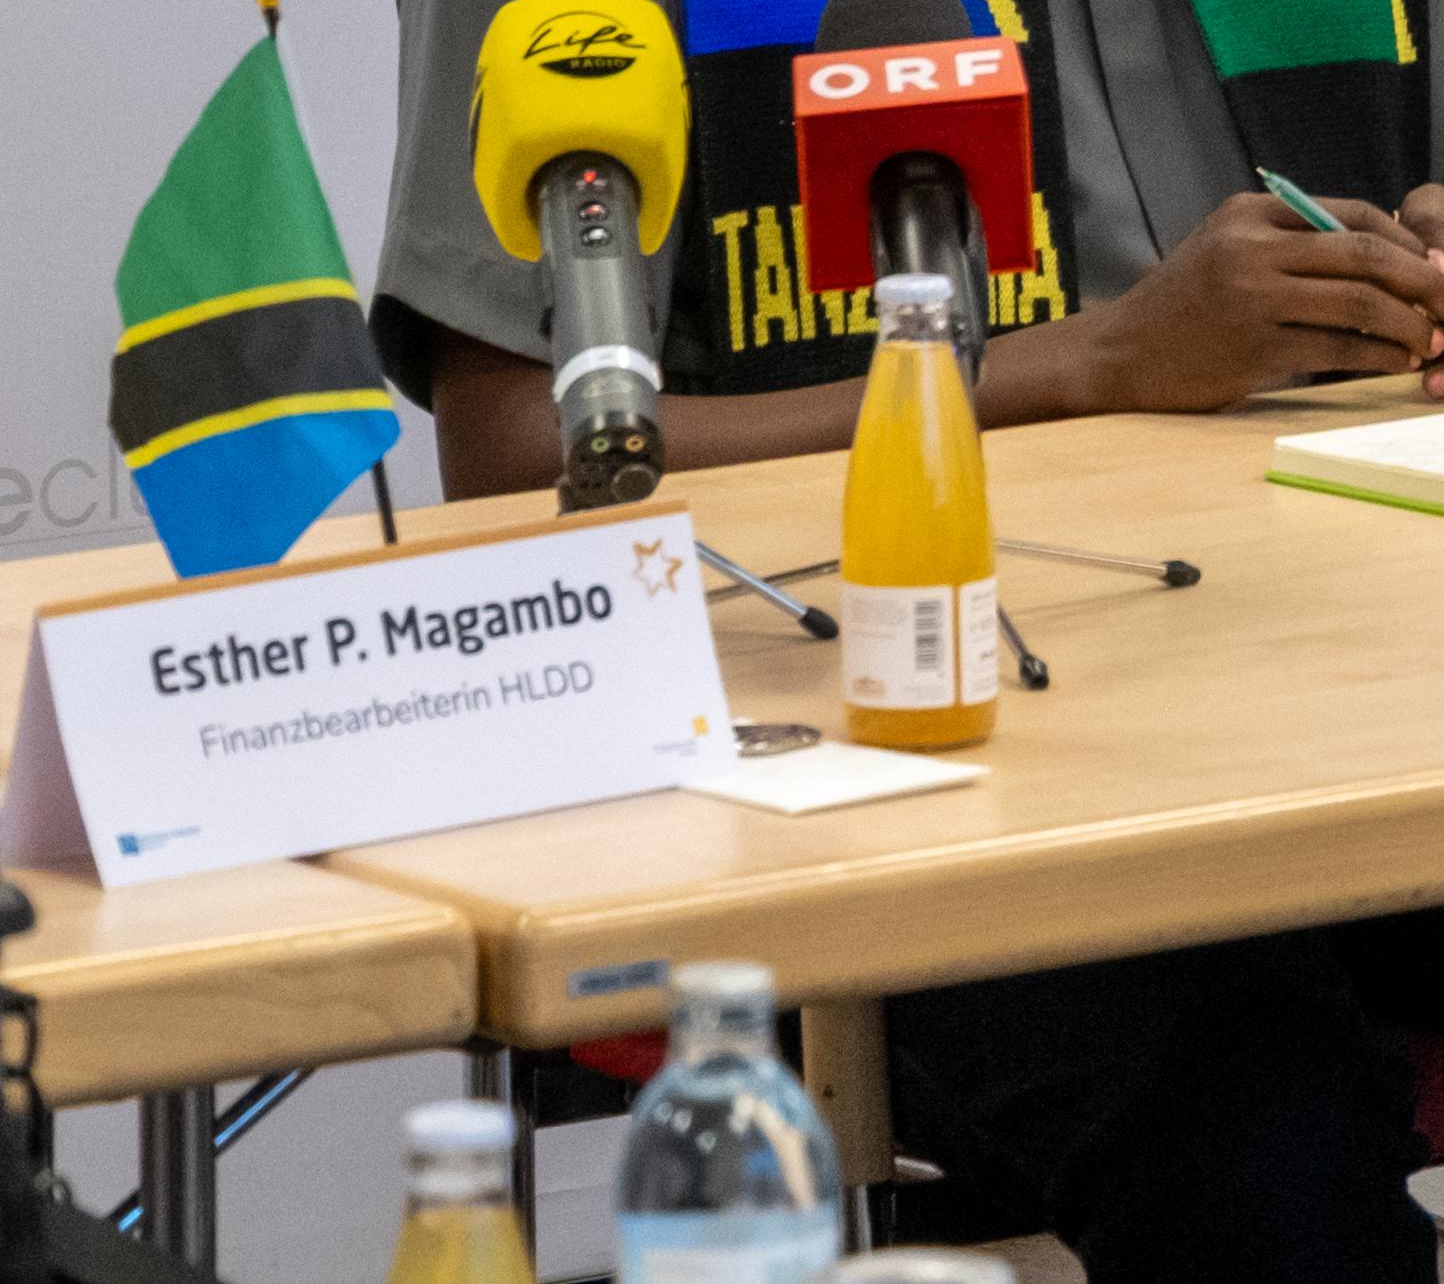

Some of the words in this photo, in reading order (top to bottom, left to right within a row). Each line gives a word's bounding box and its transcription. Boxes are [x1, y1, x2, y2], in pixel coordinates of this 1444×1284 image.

[523, 25, 646, 60] Life
[809, 49, 1004, 100] ORF
[150, 631, 309, 696] Esther
[325, 617, 367, 667] P.
[380, 579, 614, 657] Magambo
[199, 680, 494, 758] Finanzbearbeiterin
[500, 660, 595, 708] HLDD
